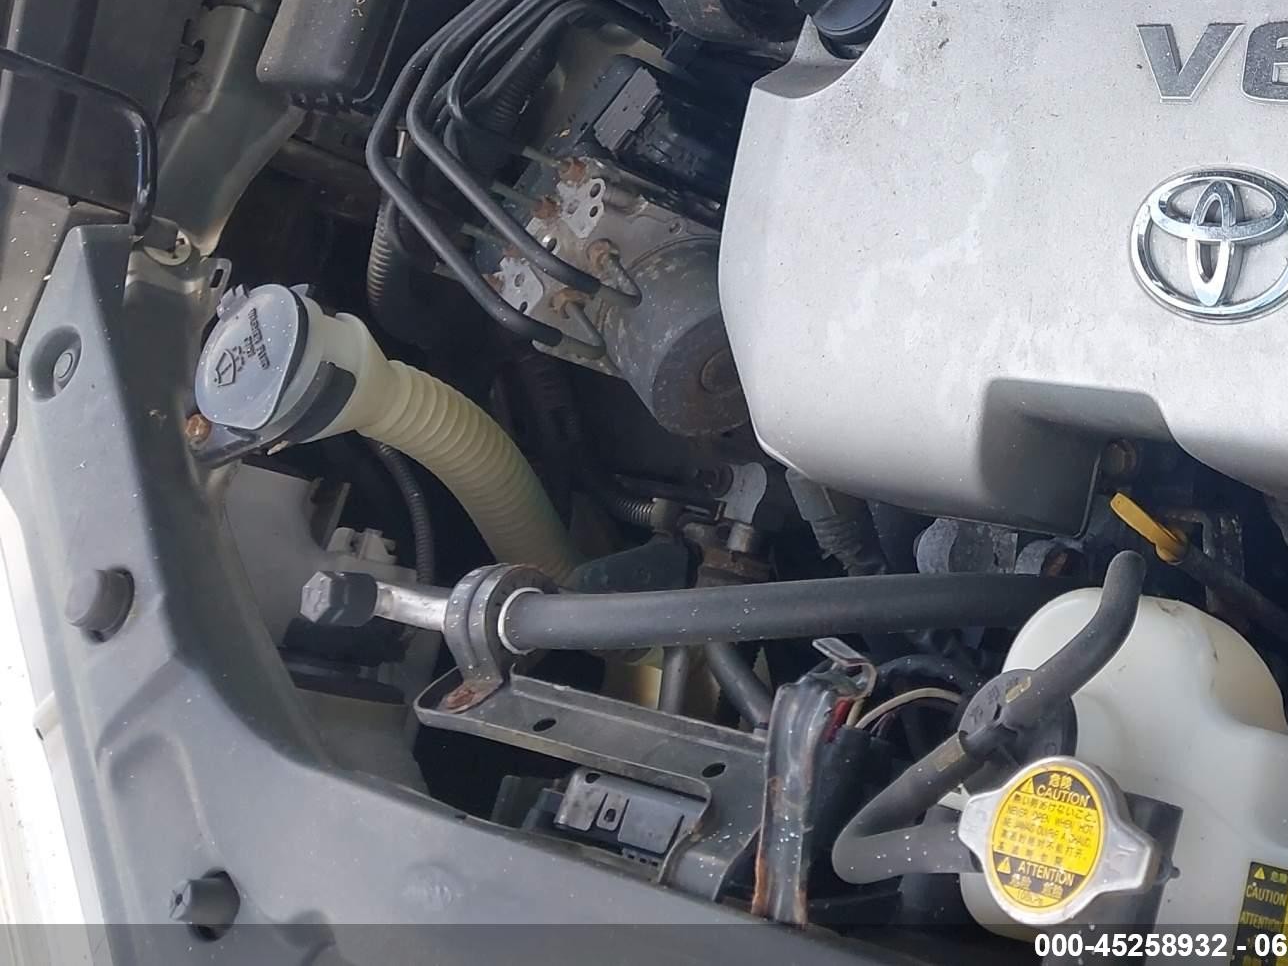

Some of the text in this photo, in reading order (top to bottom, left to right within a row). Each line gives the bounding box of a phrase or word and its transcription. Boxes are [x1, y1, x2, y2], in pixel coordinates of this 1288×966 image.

[1035, 783, 1090, 807] CAUTION
[1017, 861, 1074, 886] ATTENTION
[1246, 884, 1287, 906] CAUTION
